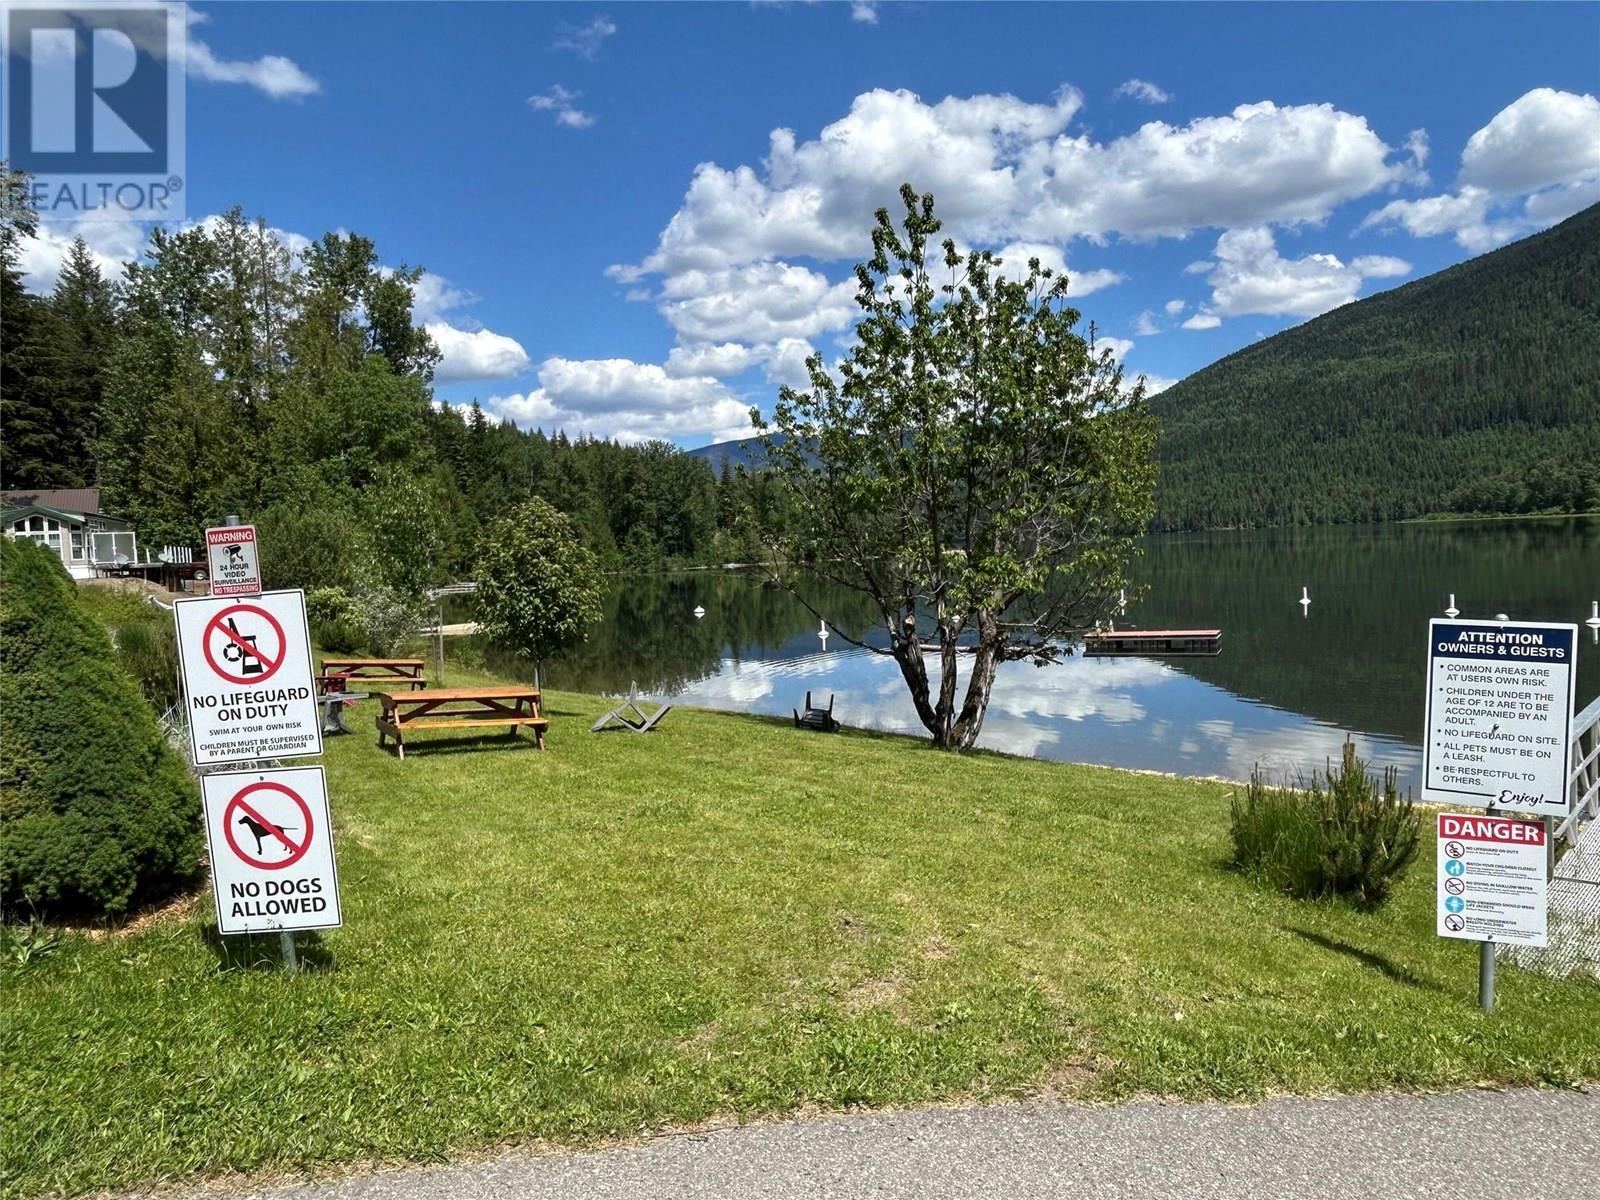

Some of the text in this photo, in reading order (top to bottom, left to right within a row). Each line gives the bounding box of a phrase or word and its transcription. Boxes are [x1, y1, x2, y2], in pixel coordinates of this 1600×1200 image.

[209, 532, 252, 542] WARNING
[224, 585, 258, 593] TRESPASSING
[1458, 632, 1543, 644] ATTENTION
[1438, 643, 1565, 657] OWNERS & GUESTS
[1447, 664, 1492, 673] COMMON
[1495, 667, 1527, 675] AREAS
[193, 687, 309, 708] NO LIFEGUARD
[1447, 687, 1494, 697] CHILDREN
[1497, 691, 1531, 700] UNDER
[218, 704, 288, 721] ON DUTY
[1446, 708, 1516, 719] ACCOMPANIED
[1445, 717, 1475, 726] ADULT.
[200, 742, 236, 750] CHILDREN
[270, 735, 314, 744] SUPERVISED
[1461, 731, 1515, 741] LIFEGUARD
[1536, 737, 1560, 745] SITE.
[227, 747, 254, 755] PARENT
[268, 743, 307, 751] GUARDIAN
[1463, 744, 1487, 752] PETS
[1490, 746, 1517, 755] MUST
[1452, 753, 1485, 762] LEASH.
[1458, 768, 1520, 780] RESPECTFUL
[1443, 776, 1484, 786] OTHERS.
[1499, 790, 1544, 806] Enjoy!
[1444, 819, 1539, 841] DANGER
[231, 878, 322, 898] NO DOGS
[232, 897, 326, 917] ALLOWED
